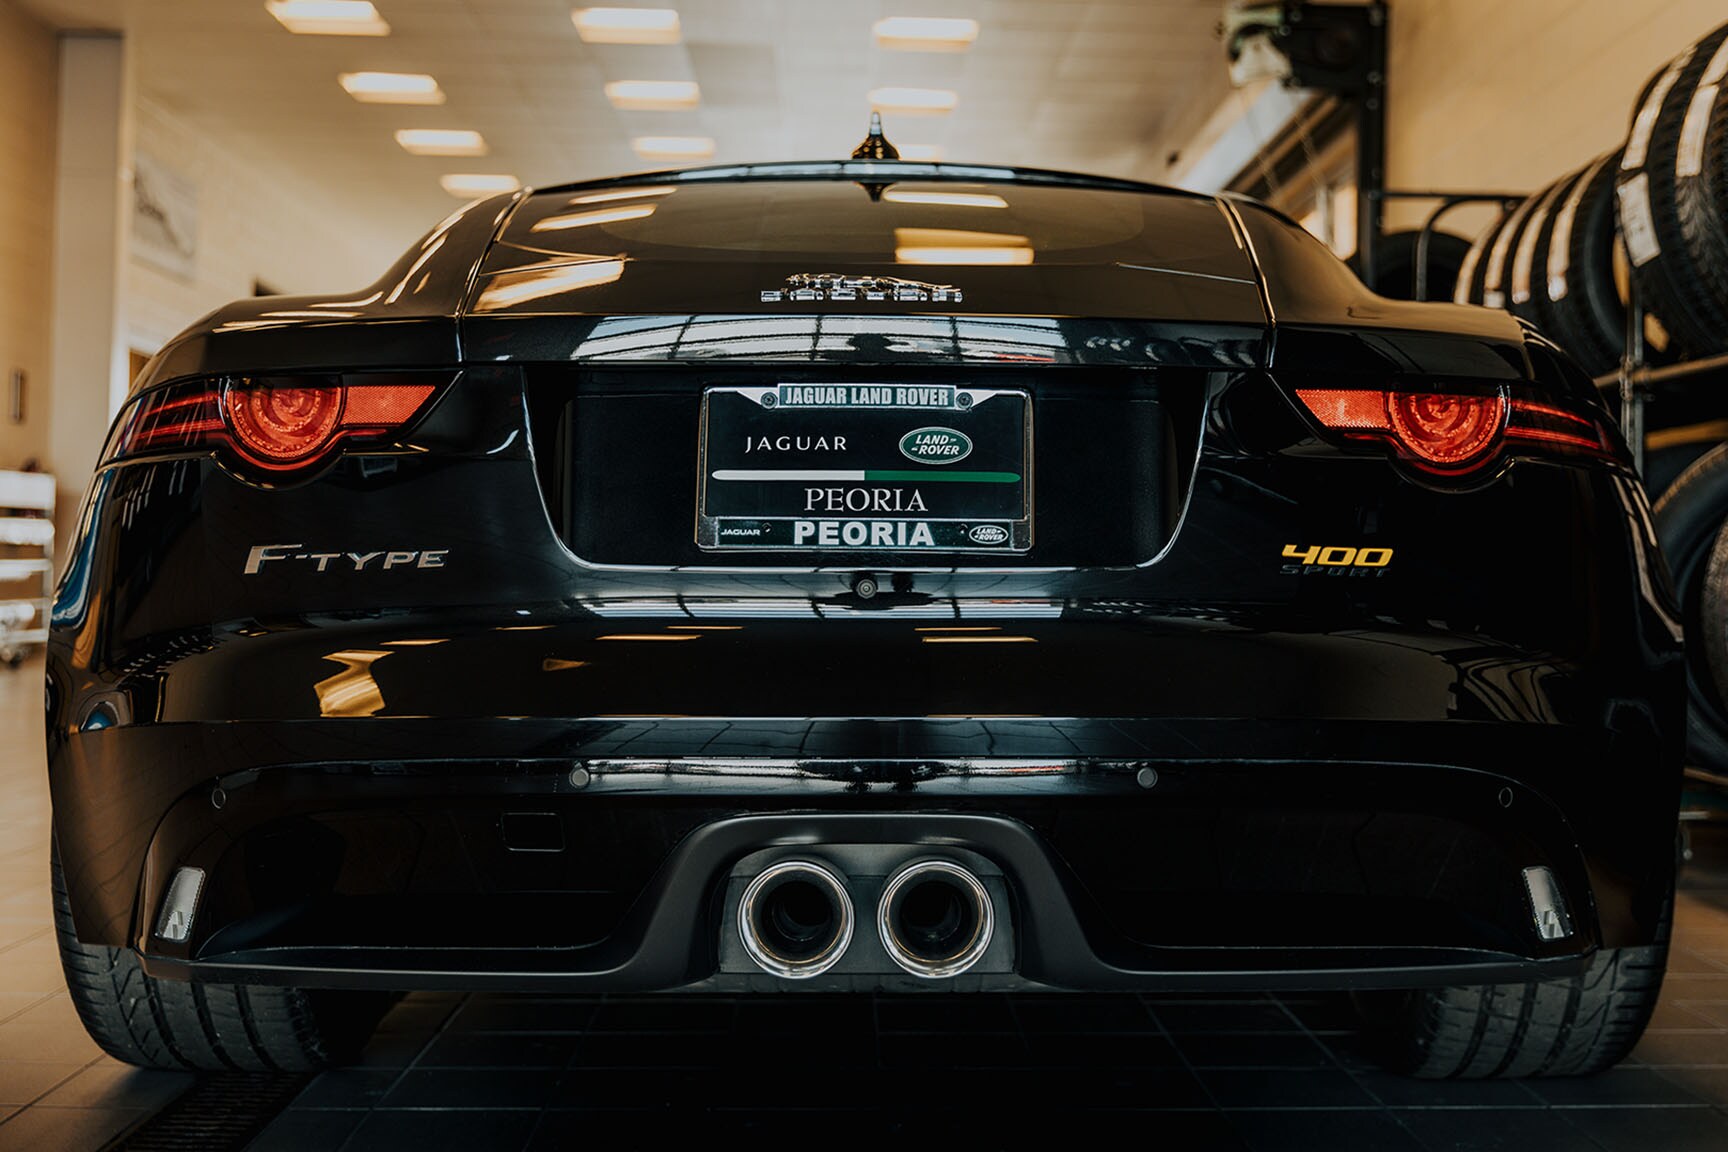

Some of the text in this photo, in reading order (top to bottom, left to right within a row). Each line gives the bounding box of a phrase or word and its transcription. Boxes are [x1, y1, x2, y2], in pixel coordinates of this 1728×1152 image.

[785, 387, 949, 406] JAGUAR LAND ROVER
[745, 436, 847, 453] JAGUAR
[803, 488, 929, 512] PEORIA
[720, 528, 761, 536] JAGUAR
[794, 522, 935, 546] PEORIA
[244, 543, 449, 575] F-TYPE
[1281, 544, 1394, 567] 400
[1280, 564, 1391, 577] SPORT
